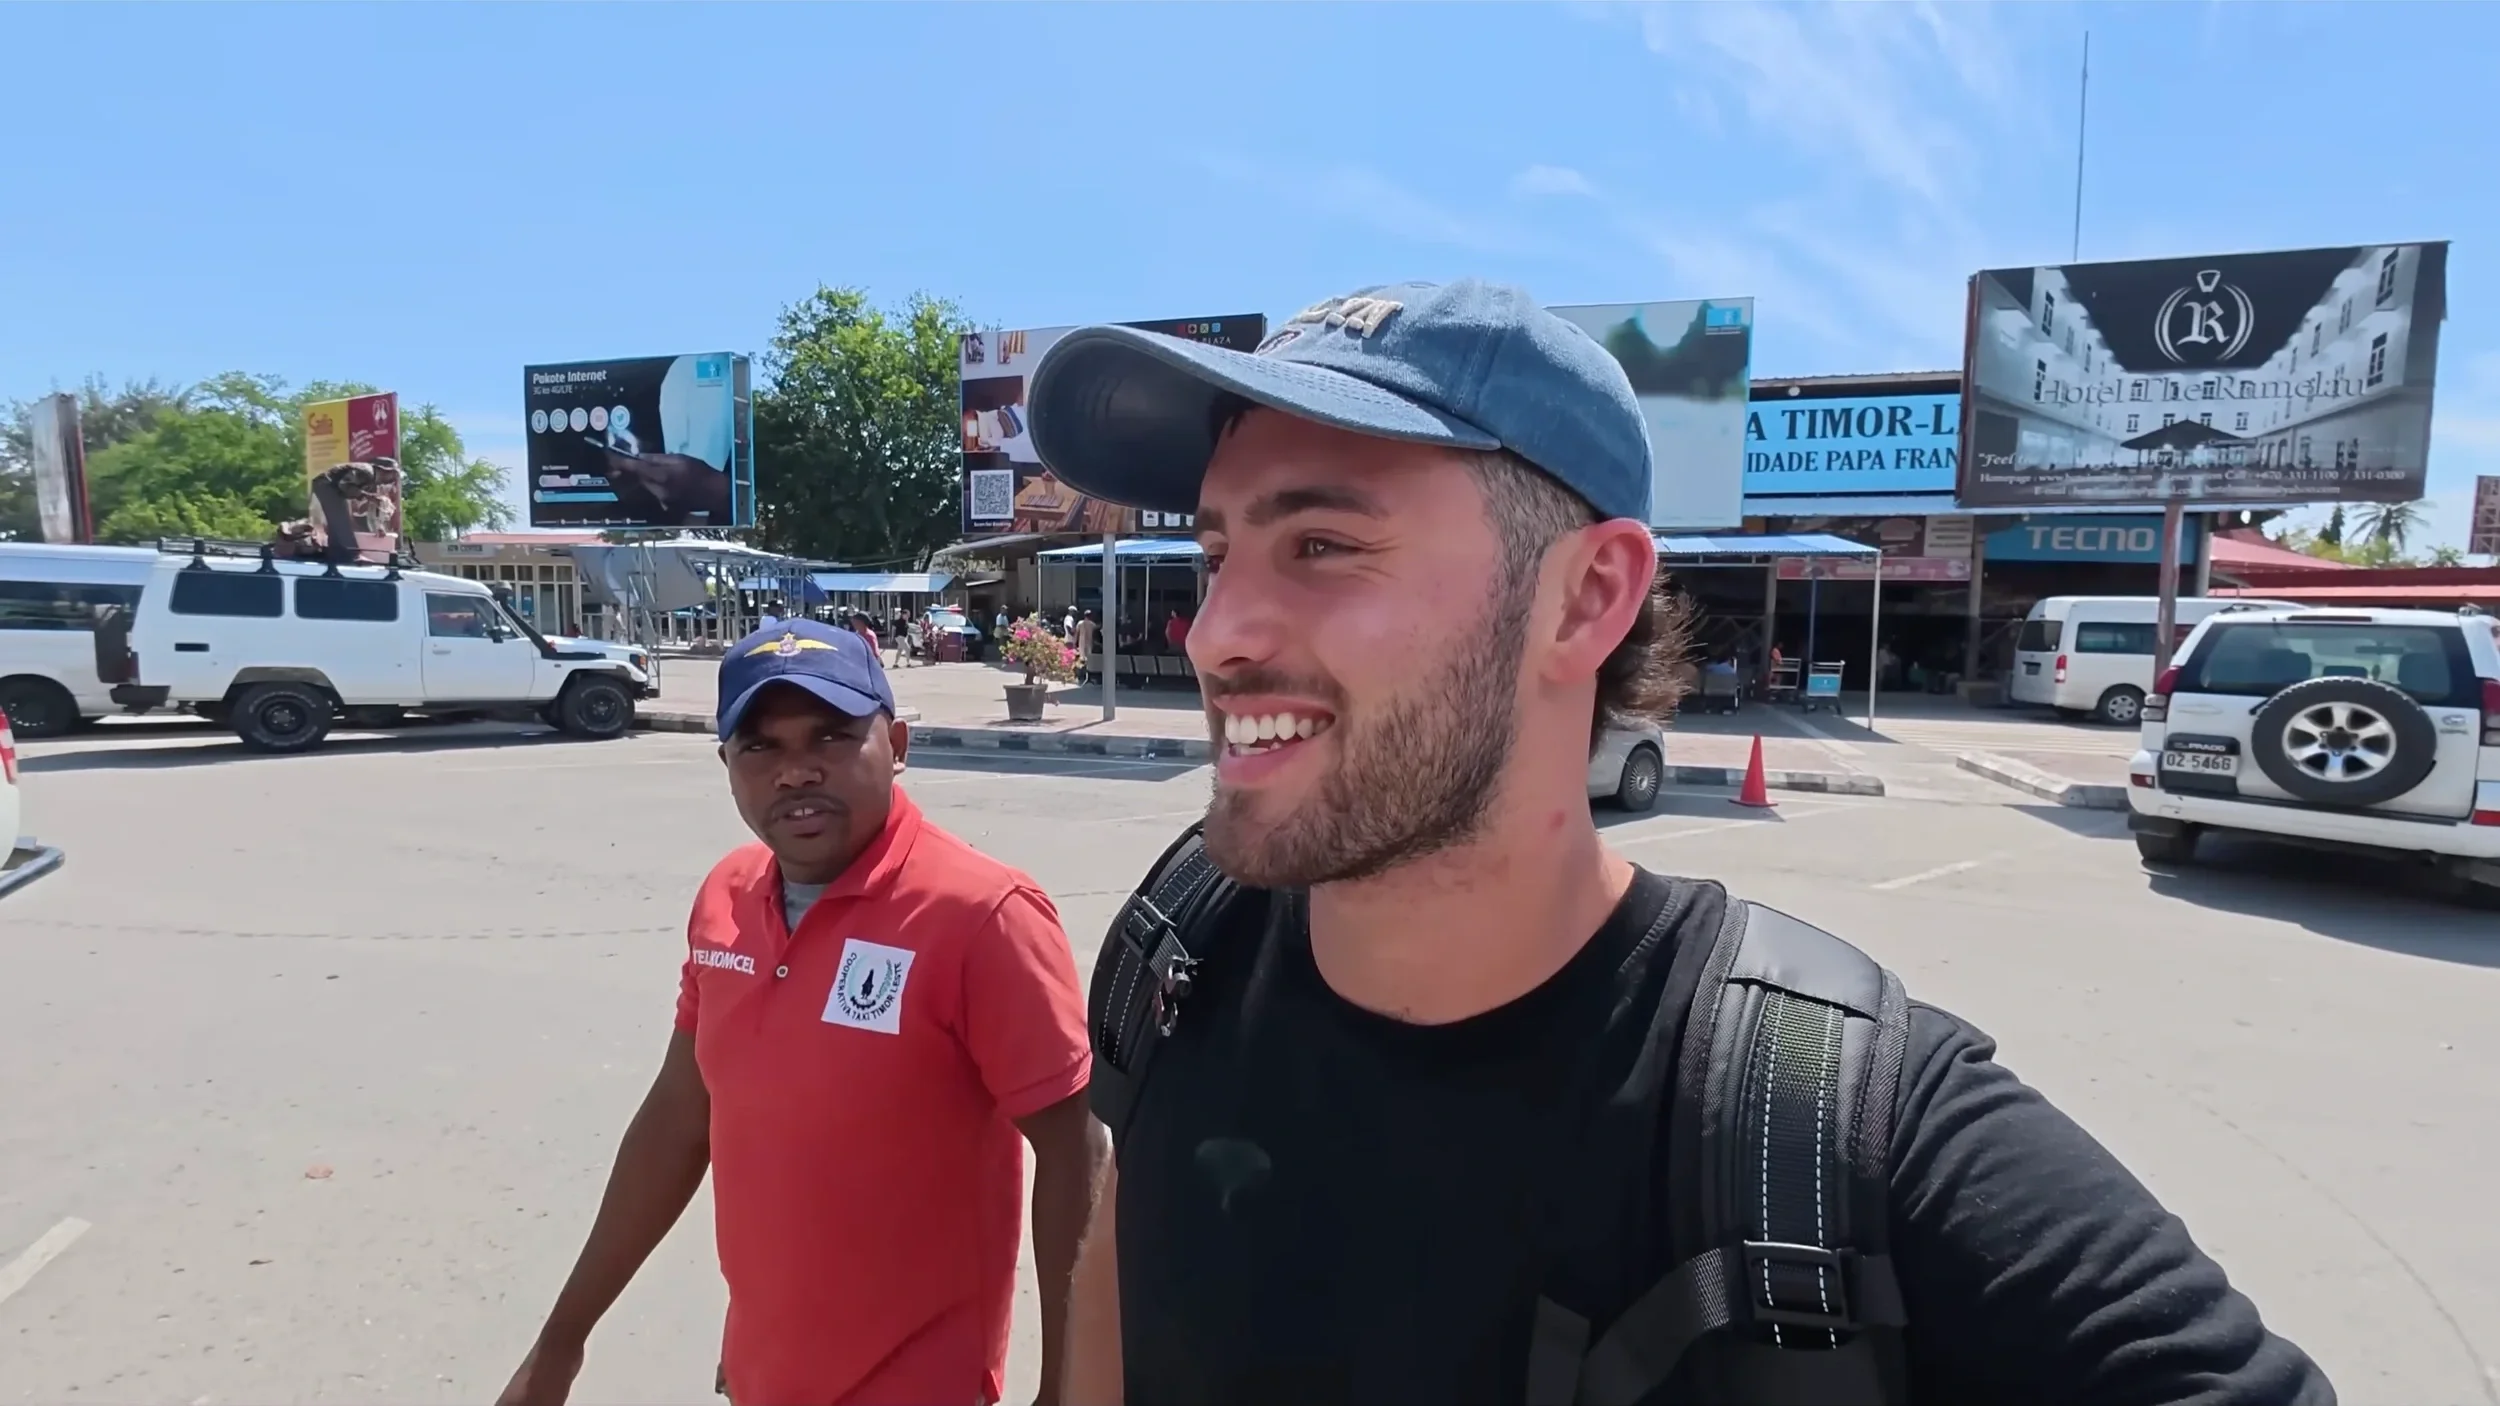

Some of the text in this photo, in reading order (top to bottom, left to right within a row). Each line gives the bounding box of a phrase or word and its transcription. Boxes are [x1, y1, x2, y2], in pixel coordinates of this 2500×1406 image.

[532, 369, 607, 385] Pakote Internet
[2034, 378, 2124, 404] Hotel
[2130, 375, 2202, 403] The
[1781, 403, 1962, 440] TIMOR-L
[1826, 448, 1886, 471] PAPA
[2025, 526, 2156, 552] TECNO
[2188, 742, 2226, 751] PRADO
[692, 949, 755, 975] TELKOMCEL
[870, 994, 895, 1019] TIMOR
[890, 961, 902, 993] LESTE
